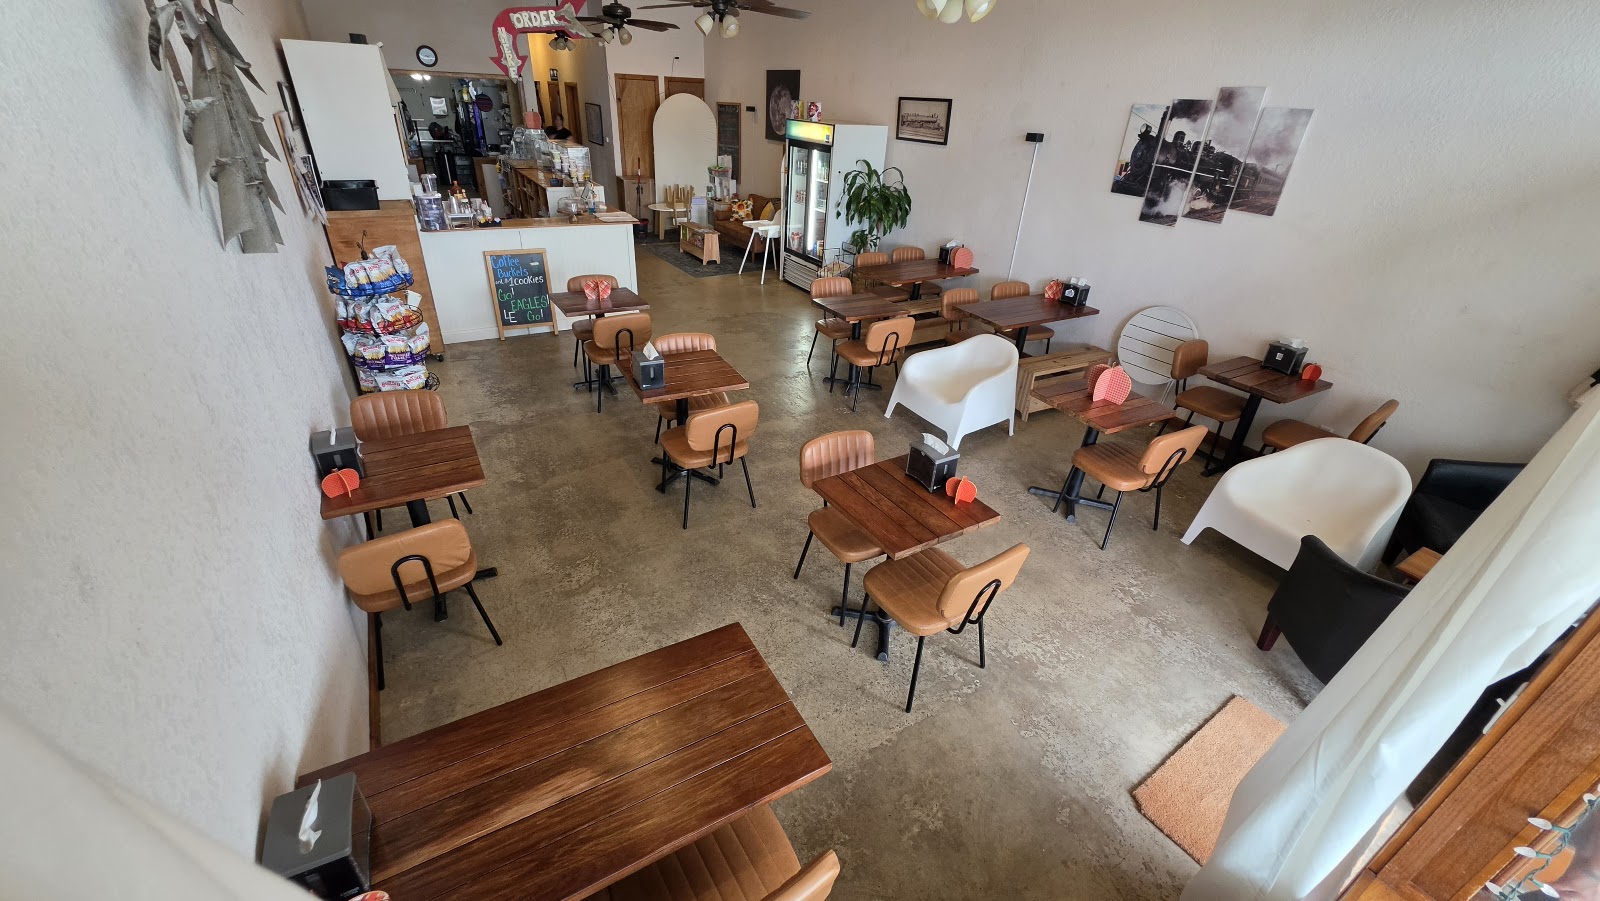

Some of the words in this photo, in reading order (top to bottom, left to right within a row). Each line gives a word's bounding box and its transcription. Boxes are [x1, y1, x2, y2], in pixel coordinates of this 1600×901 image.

[513, 9, 559, 29] ORDER
[497, 27, 519, 80] HERE
[490, 255, 520, 269] Coffee
[497, 266, 529, 279] Buckets
